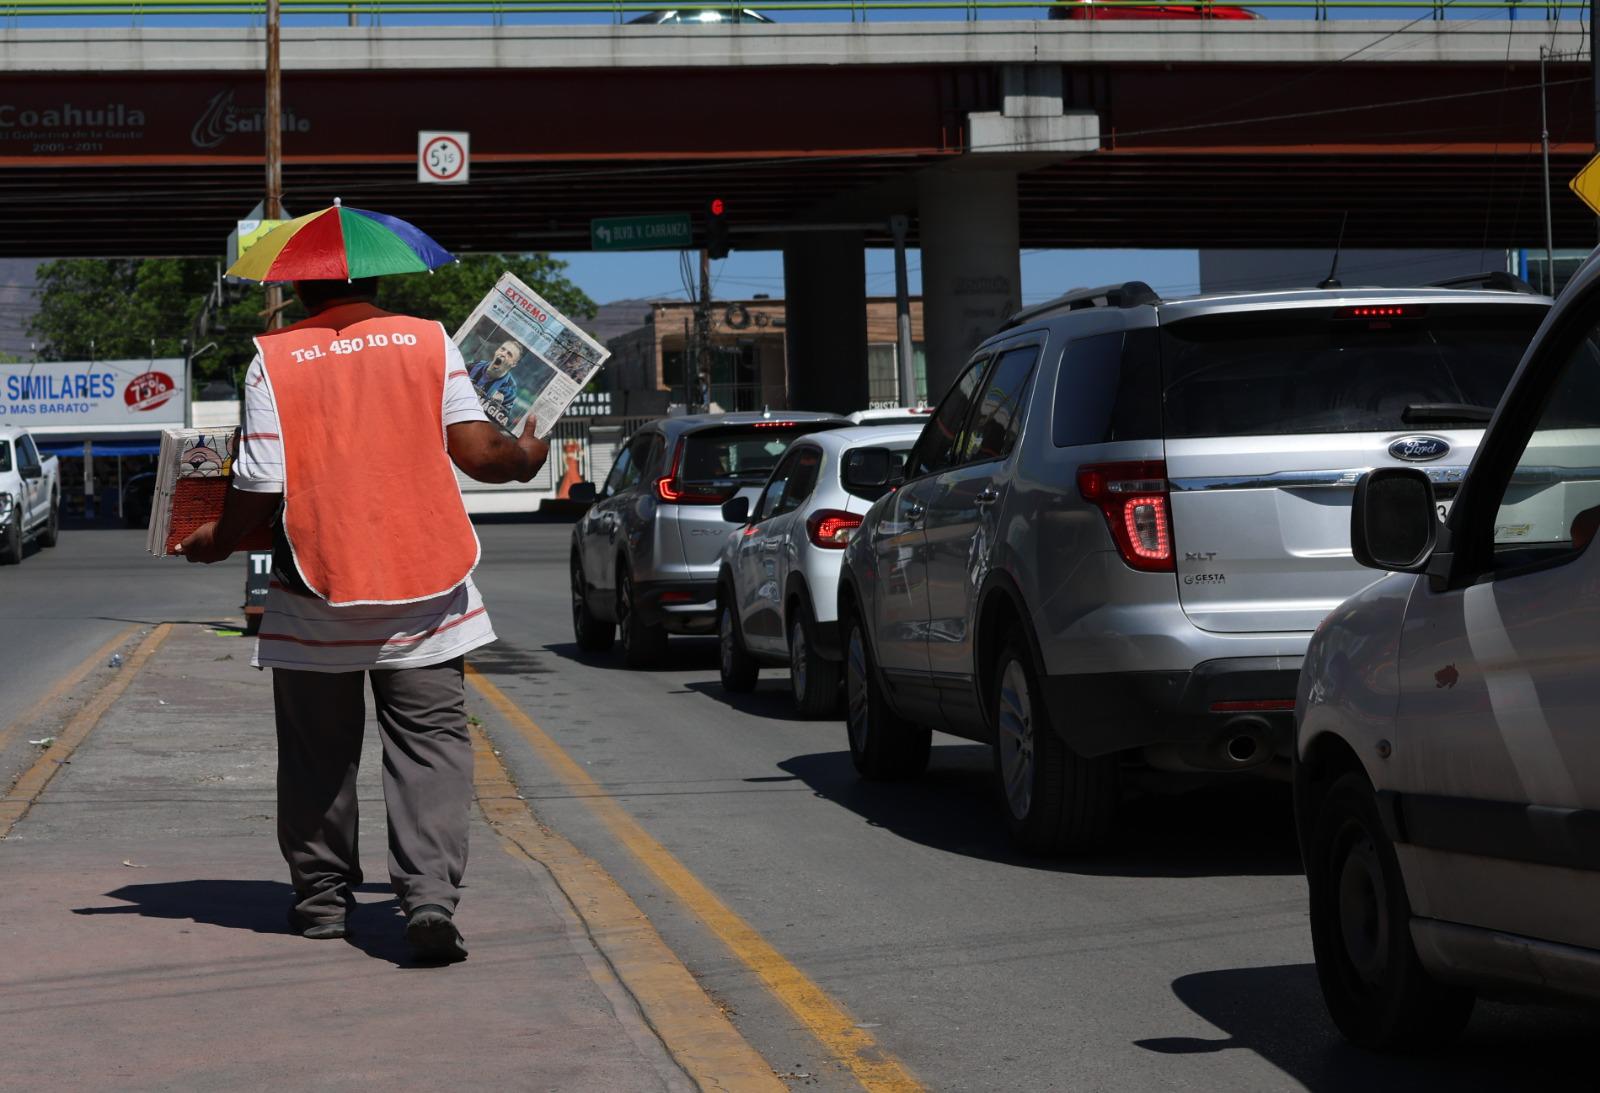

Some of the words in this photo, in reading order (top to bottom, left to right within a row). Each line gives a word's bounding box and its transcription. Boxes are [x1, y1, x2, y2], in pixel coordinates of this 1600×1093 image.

[0, 102, 145, 128] Coahuila
[645, 222, 689, 239] CARRANZA
[505, 287, 547, 323] EXTREMO
[291, 345, 326, 363] Tel.
[329, 338, 364, 355] 450
[366, 334, 388, 347] 10
[391, 333, 417, 346] 00
[7, 373, 115, 400] SIMILARES
[10, 404, 37, 414] MAS
[40, 402, 89, 413] BARATO
[1404, 440, 1438, 456] Ford
[1185, 552, 1217, 561] XLT
